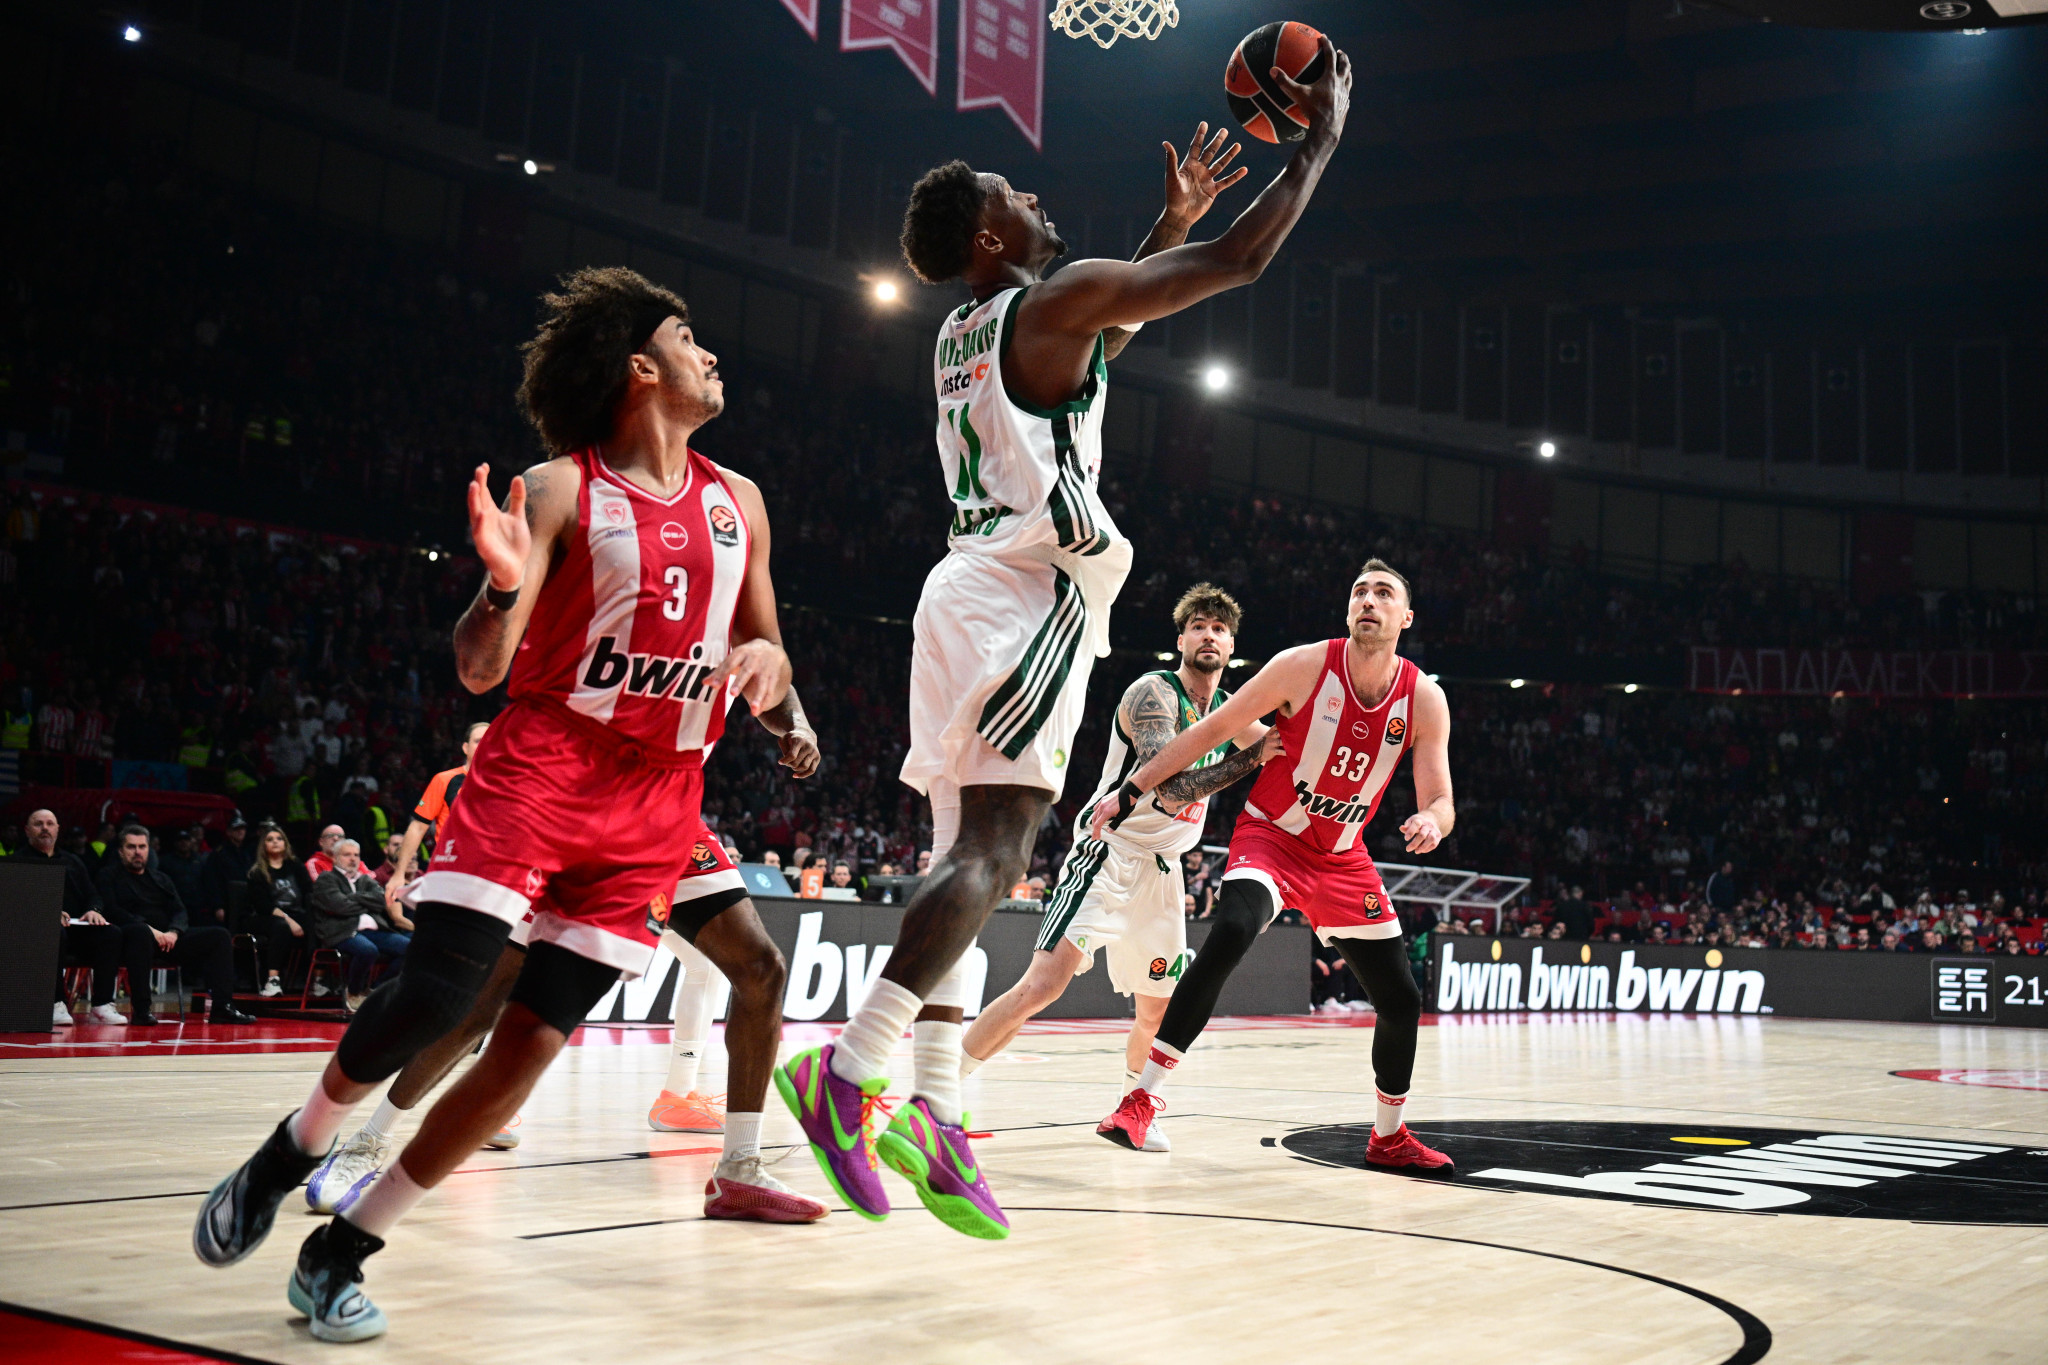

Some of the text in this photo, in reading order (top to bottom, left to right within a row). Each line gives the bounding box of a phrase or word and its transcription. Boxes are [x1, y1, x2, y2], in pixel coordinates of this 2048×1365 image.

[662, 566, 689, 621] 3
[582, 635, 718, 703] bwin
[1330, 745, 1371, 782] 33
[1294, 779, 1371, 823] bwin
[807, 875, 820, 897] 5
[1438, 940, 1766, 1013] bwin bwin bwin
[1467, 1134, 2013, 1210] bwin
